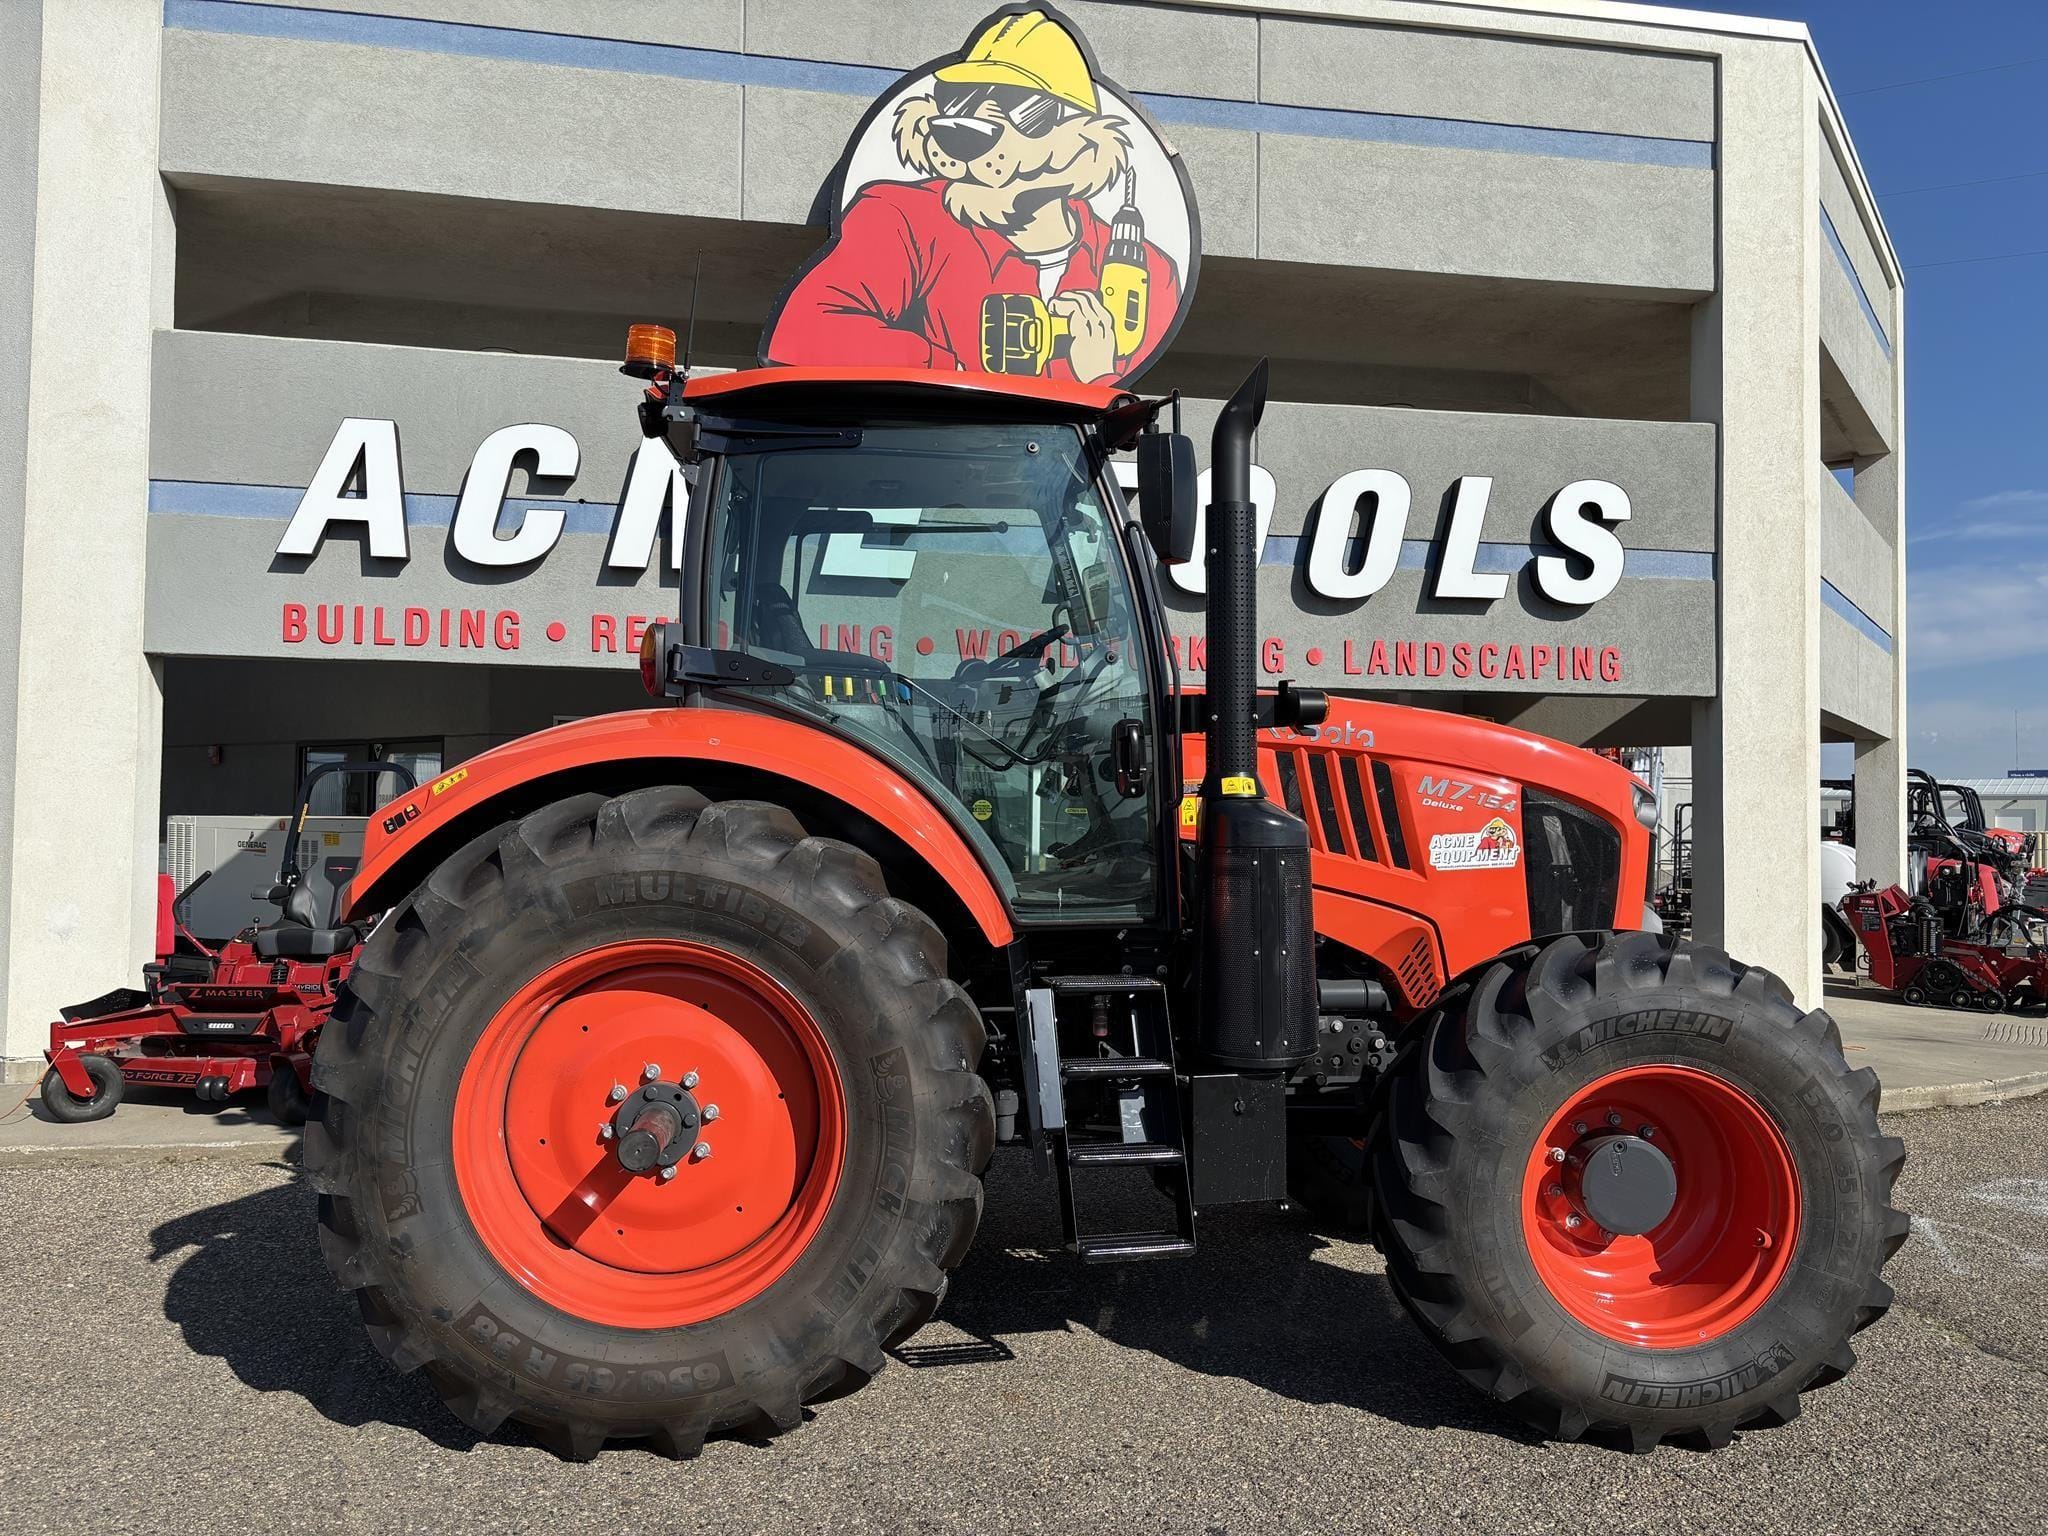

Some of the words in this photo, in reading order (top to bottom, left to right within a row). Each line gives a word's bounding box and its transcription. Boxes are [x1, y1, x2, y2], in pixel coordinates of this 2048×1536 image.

[1108, 461, 1633, 605] OLS
[282, 603, 520, 650] BUILDING
[592, 614, 893, 662] REING
[1343, 638, 1622, 683] LANDSCAPING
[1417, 775, 1517, 812] M7-154
[1421, 798, 1464, 812] Deluxe
[237, 839, 267, 849] GENERAC
[1431, 834, 1475, 849] ACME
[1432, 847, 1519, 864] EQUIPMENT
[597, 872, 812, 948] MULTIBIB
[188, 988, 202, 998] Z
[205, 989, 264, 999] MASTER
[1579, 1011, 1731, 1050] MICHELIN
[135, 1072, 176, 1081] FORCE
[176, 1073, 197, 1083] 72
[1602, 1365, 1758, 1408] MICHELIN
